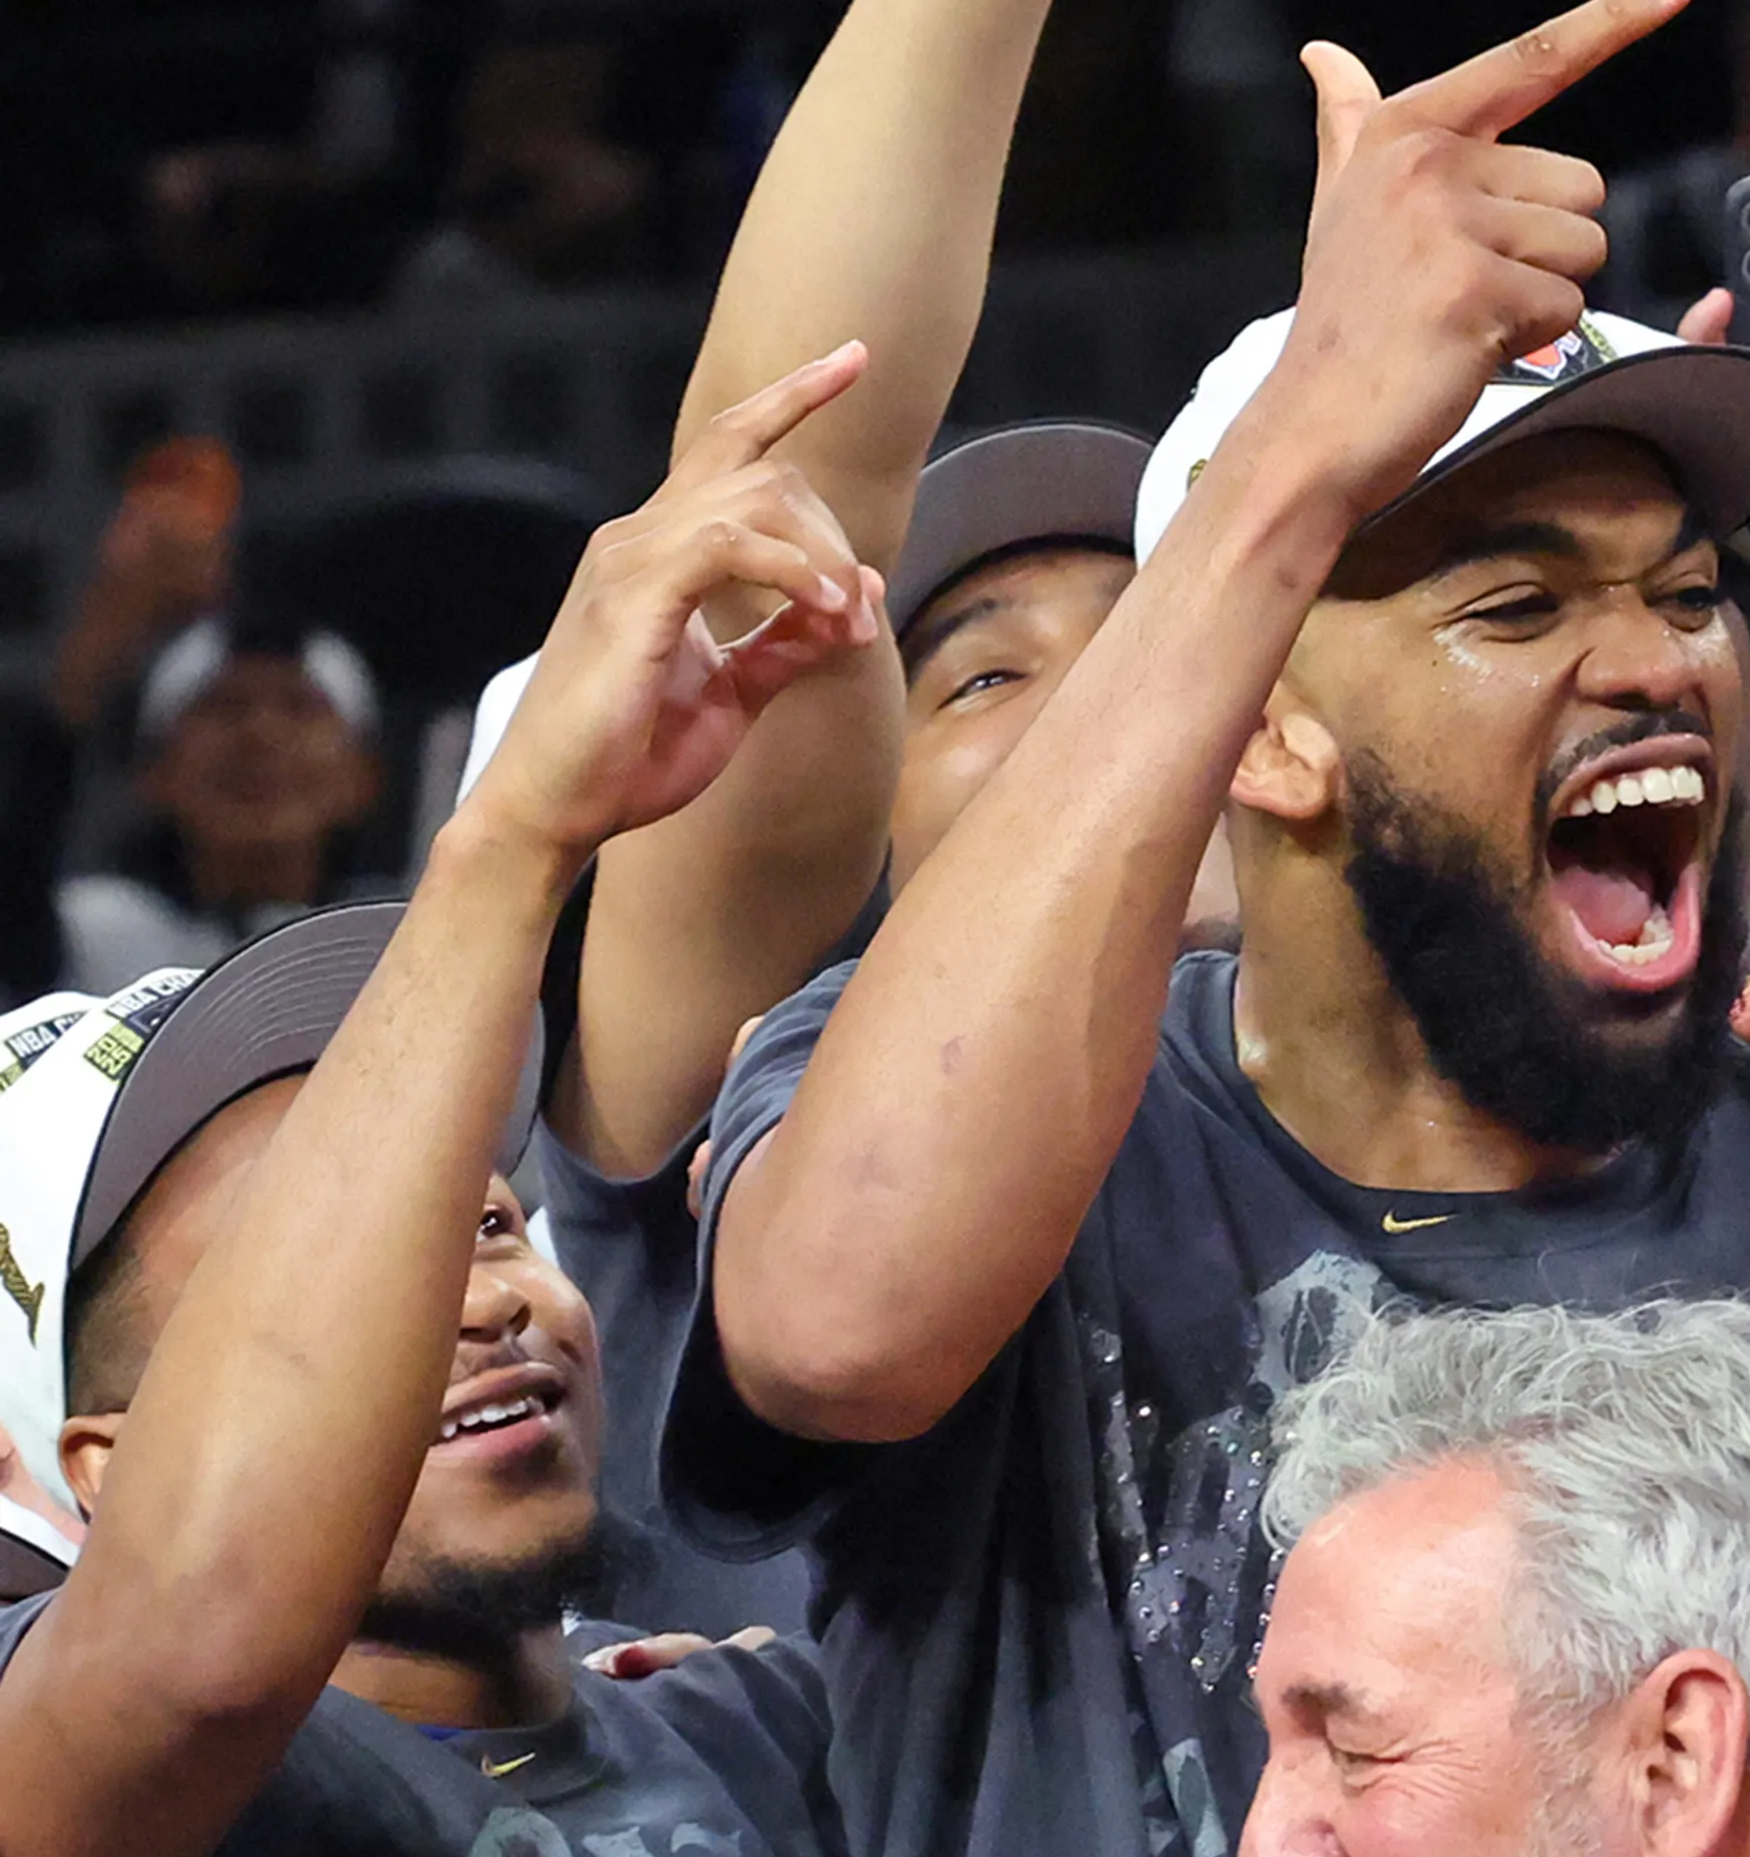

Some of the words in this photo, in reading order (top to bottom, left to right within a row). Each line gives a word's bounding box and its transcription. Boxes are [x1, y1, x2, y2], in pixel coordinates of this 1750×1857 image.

[107, 989, 158, 1018] NBA
[8, 1027, 56, 1059] NBA
[86, 1034, 115, 1063] 20
[102, 1048, 133, 1076] 25
